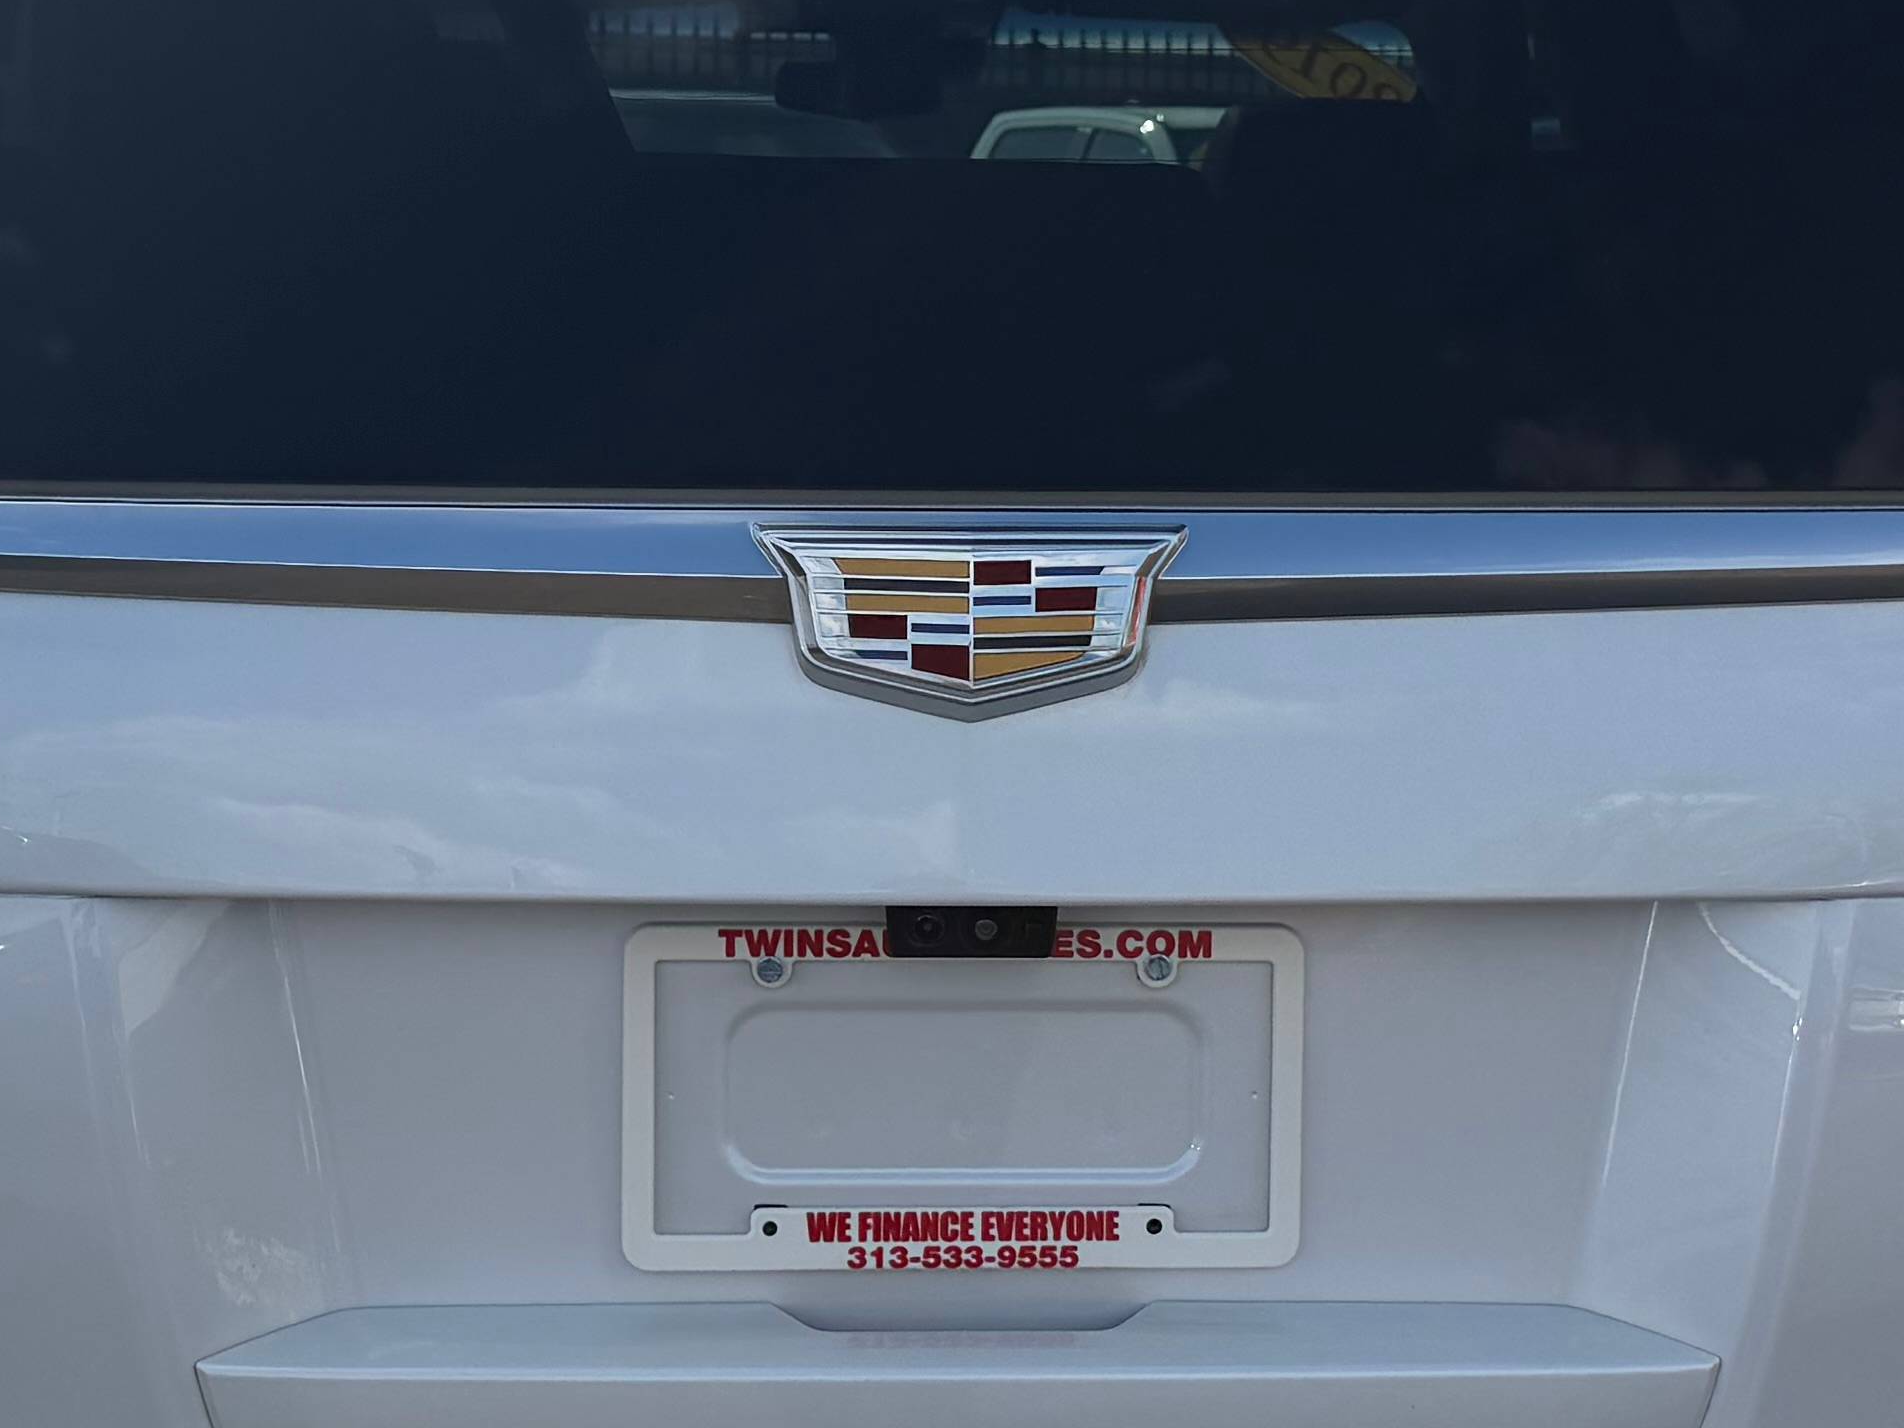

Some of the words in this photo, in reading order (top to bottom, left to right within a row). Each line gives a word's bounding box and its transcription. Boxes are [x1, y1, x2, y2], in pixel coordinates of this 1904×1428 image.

[718, 929, 1213, 959] TWINSAES.COM
[806, 1211, 852, 1243] WE
[858, 1211, 975, 1243] FINANCE
[981, 1210, 1120, 1242] EVERYONE
[847, 1245, 1080, 1269] 313-533-9555
